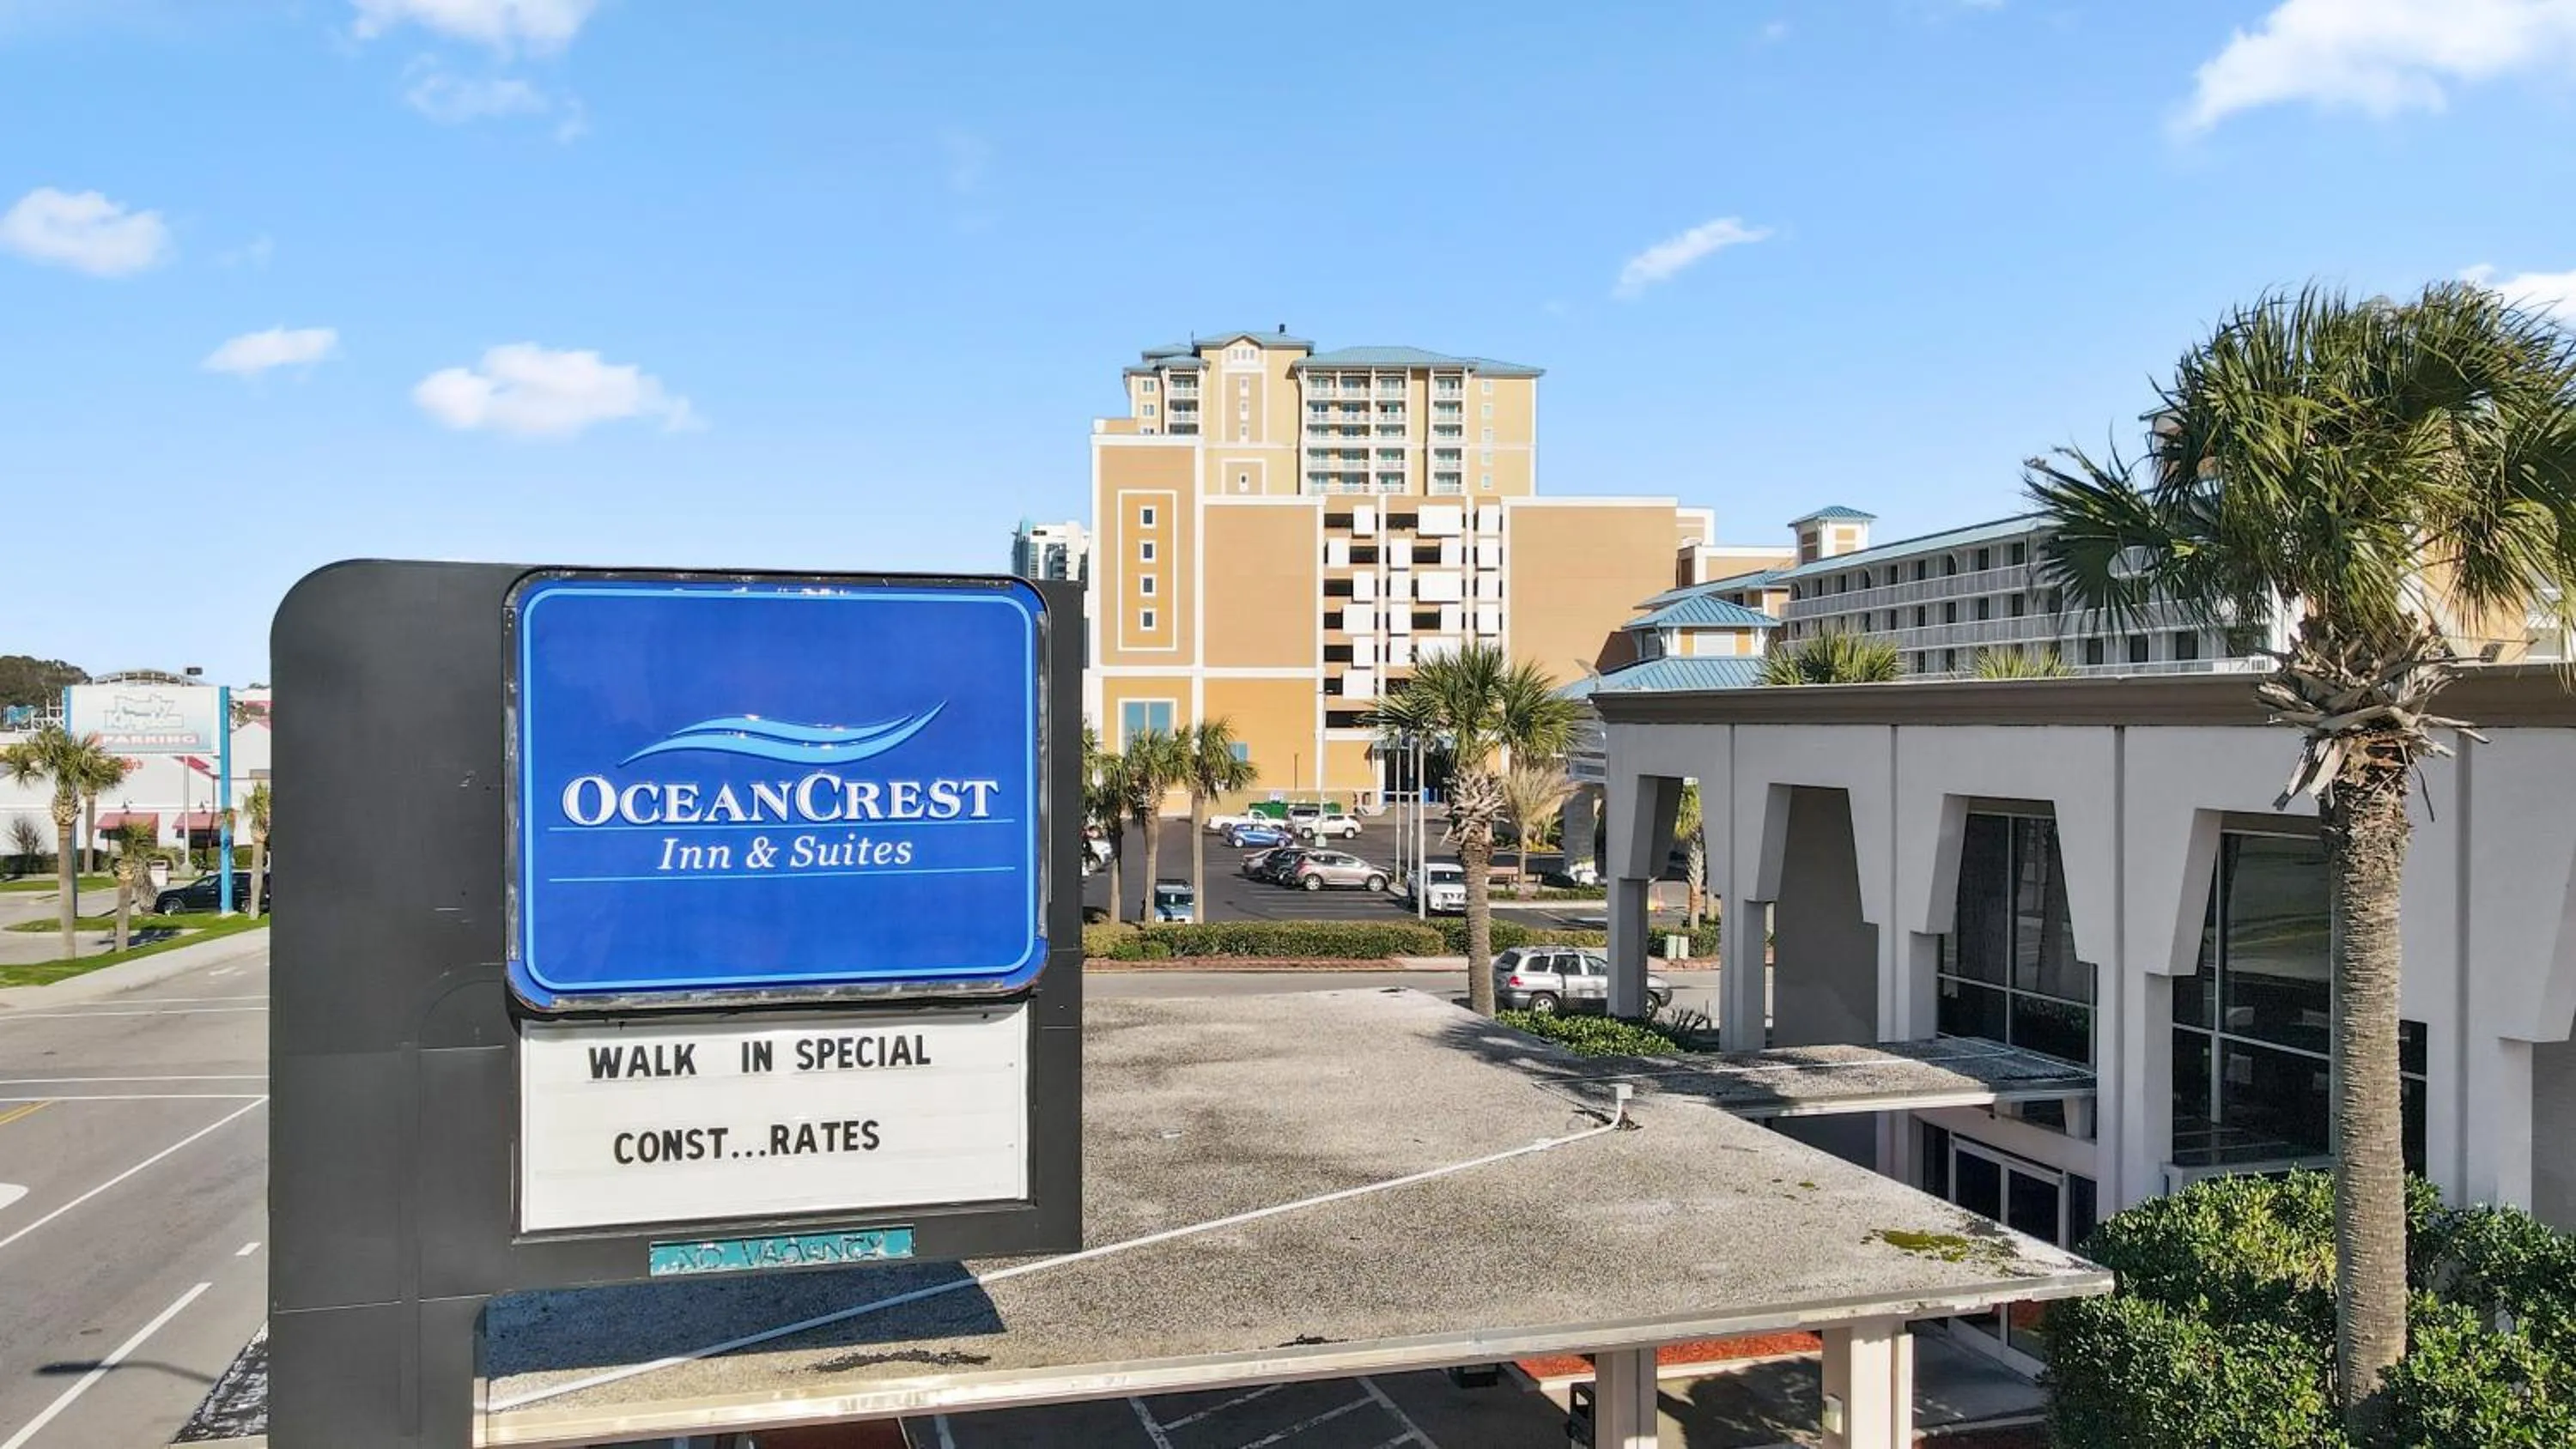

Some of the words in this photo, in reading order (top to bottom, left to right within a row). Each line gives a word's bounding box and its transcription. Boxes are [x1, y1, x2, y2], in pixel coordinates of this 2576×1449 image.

[101, 733, 198, 745] PARKING
[658, 837, 732, 870] Inn
[746, 835, 781, 869] &
[790, 833, 913, 868] Suites
[589, 1043, 697, 1079] WALK
[741, 1040, 773, 1073] IN
[796, 1034, 932, 1070] SPECIAL
[677, 1241, 725, 1269] NO
[742, 1229, 884, 1266] VACANCY
